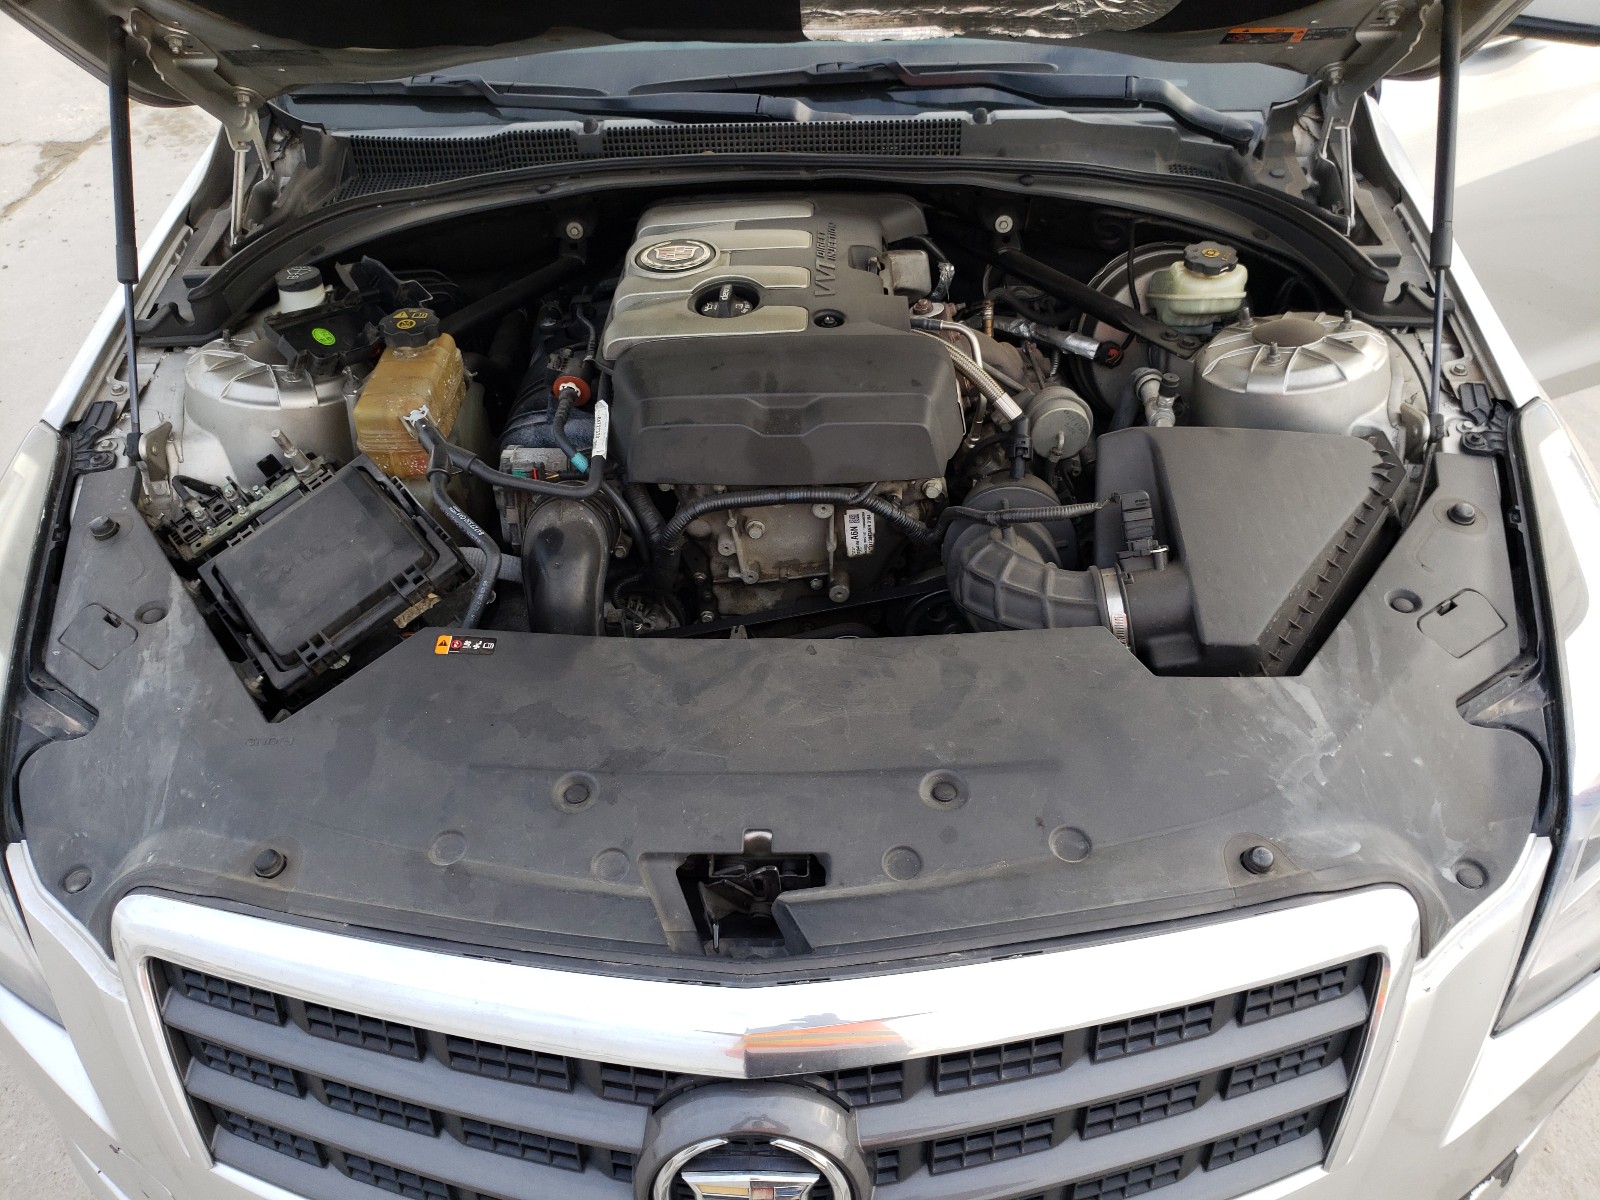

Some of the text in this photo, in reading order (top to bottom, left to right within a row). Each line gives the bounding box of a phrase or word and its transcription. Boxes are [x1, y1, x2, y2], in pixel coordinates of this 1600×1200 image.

[815, 231, 826, 258] DIRECT
[827, 222, 837, 261] INJECTION
[814, 258, 836, 297] VVT
[850, 526, 859, 540] A6N
